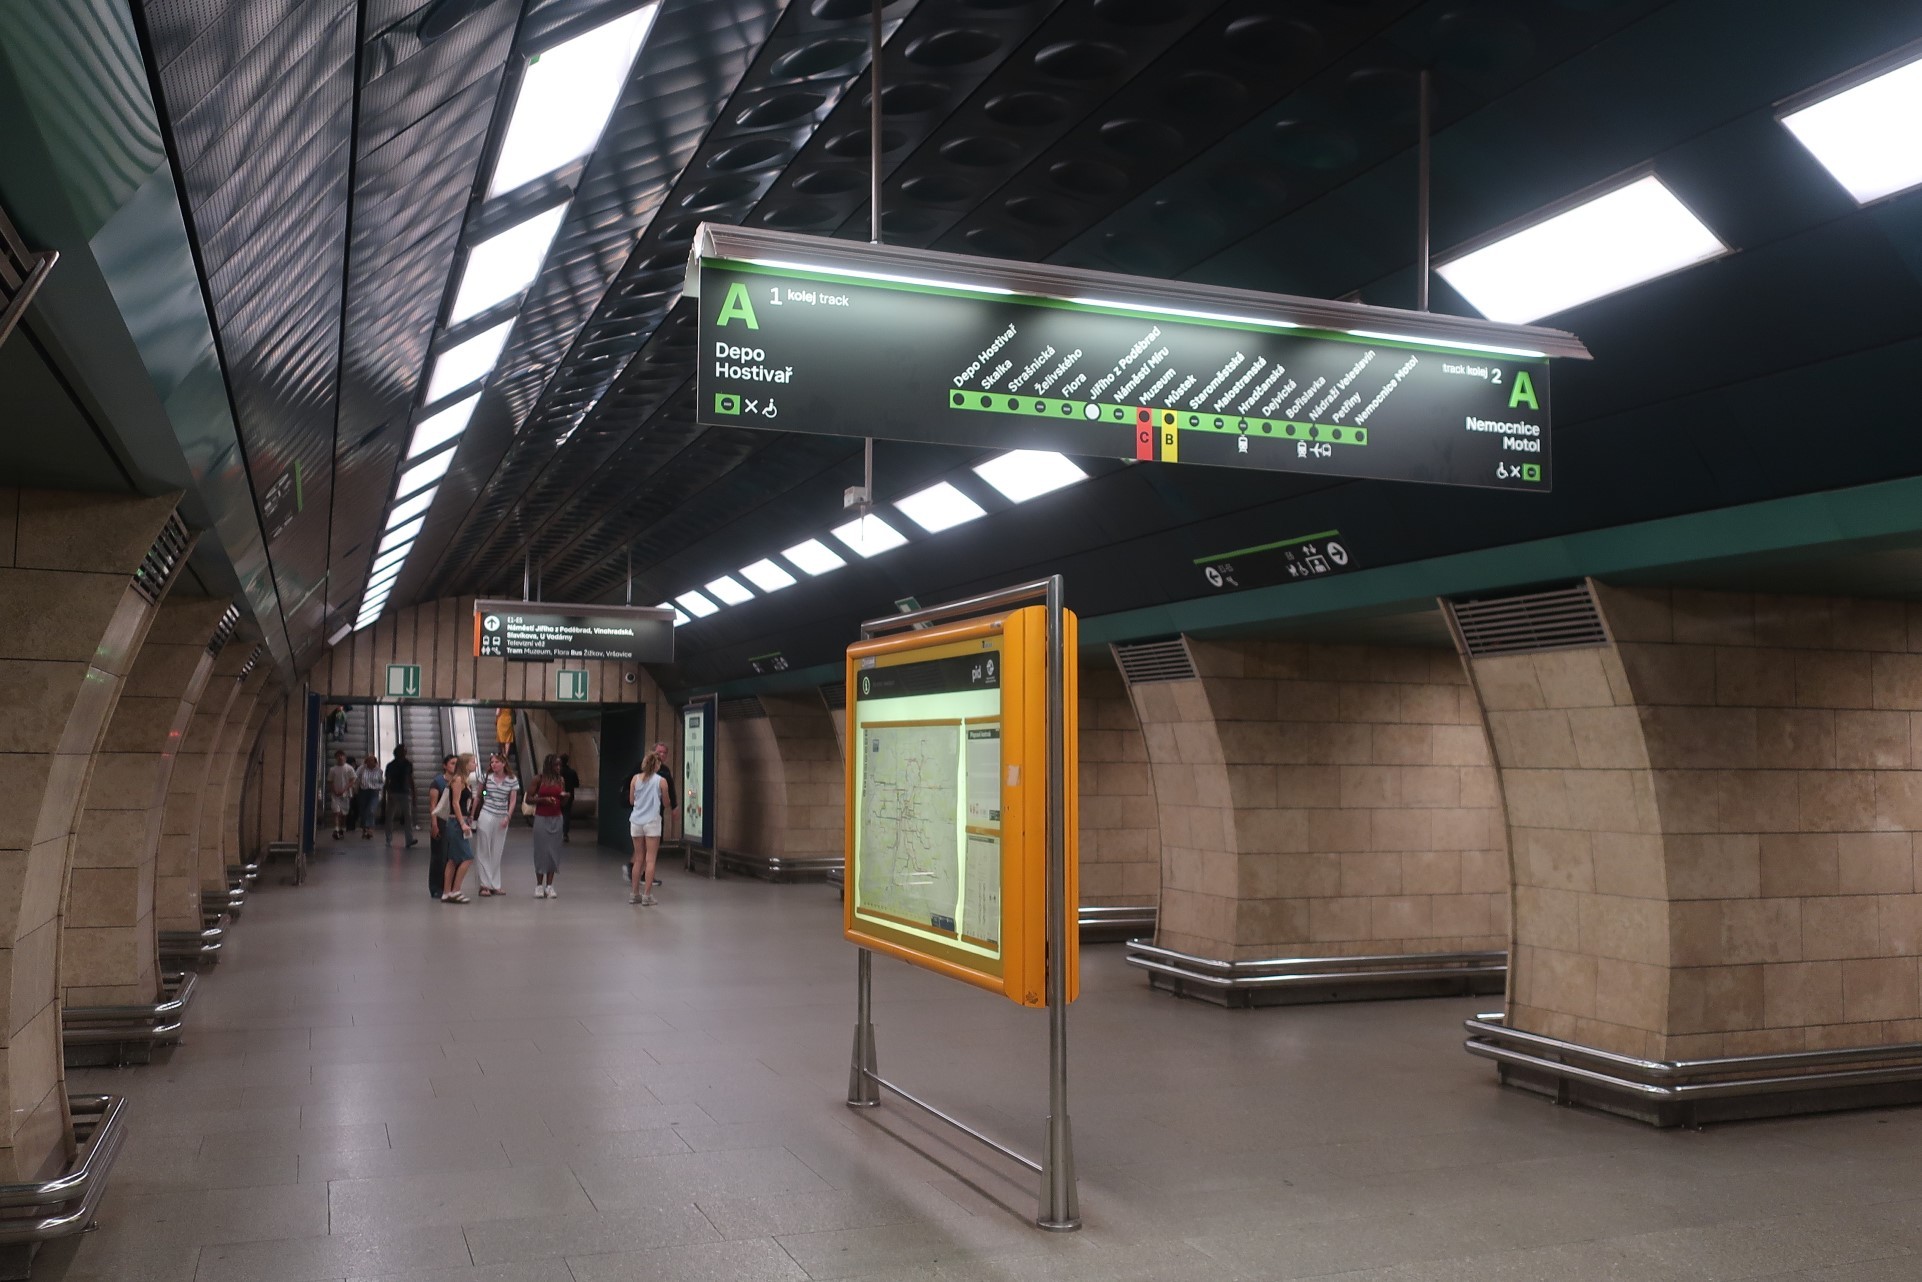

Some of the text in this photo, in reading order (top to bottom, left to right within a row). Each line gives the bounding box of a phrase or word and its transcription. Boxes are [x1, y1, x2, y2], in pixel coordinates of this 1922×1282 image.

[716, 282, 759, 330] A
[770, 287, 849, 306] 1 kolej track
[715, 342, 765, 363] Depo
[953, 322, 1018, 387] Depo Hostivař
[1008, 344, 1056, 392] Strašnická
[1089, 325, 1161, 400] Jiřího z Poděbrad
[715, 362, 793, 383] Hostivař
[981, 360, 1013, 390] Skalka
[1034, 348, 1083, 395] Želivského
[1061, 372, 1087, 398] Flora
[1113, 346, 1170, 403] Náměstí Míru
[1139, 368, 1177, 405] Muzeum
[1189, 351, 1245, 410] Staroměstská
[1213, 355, 1267, 412] Malostranská
[1238, 363, 1285, 415] Hradčanská
[1354, 354, 1418, 425] Nemocnice Motol
[1442, 363, 1502, 384] track kolej 2
[1164, 374, 1197, 408] Můstek
[1262, 378, 1297, 417] Dejvická
[1285, 376, 1326, 419] Bořislavka
[1309, 385, 1340, 421] Nádraží
[1332, 391, 1361, 423] Petřiny
[1508, 371, 1539, 410] A
[1139, 431, 1149, 443] C
[1165, 434, 1174, 445] B
[1465, 416, 1540, 436] Nemocnice
[1503, 436, 1540, 453] Motol
[972, 665, 981, 683] pid
